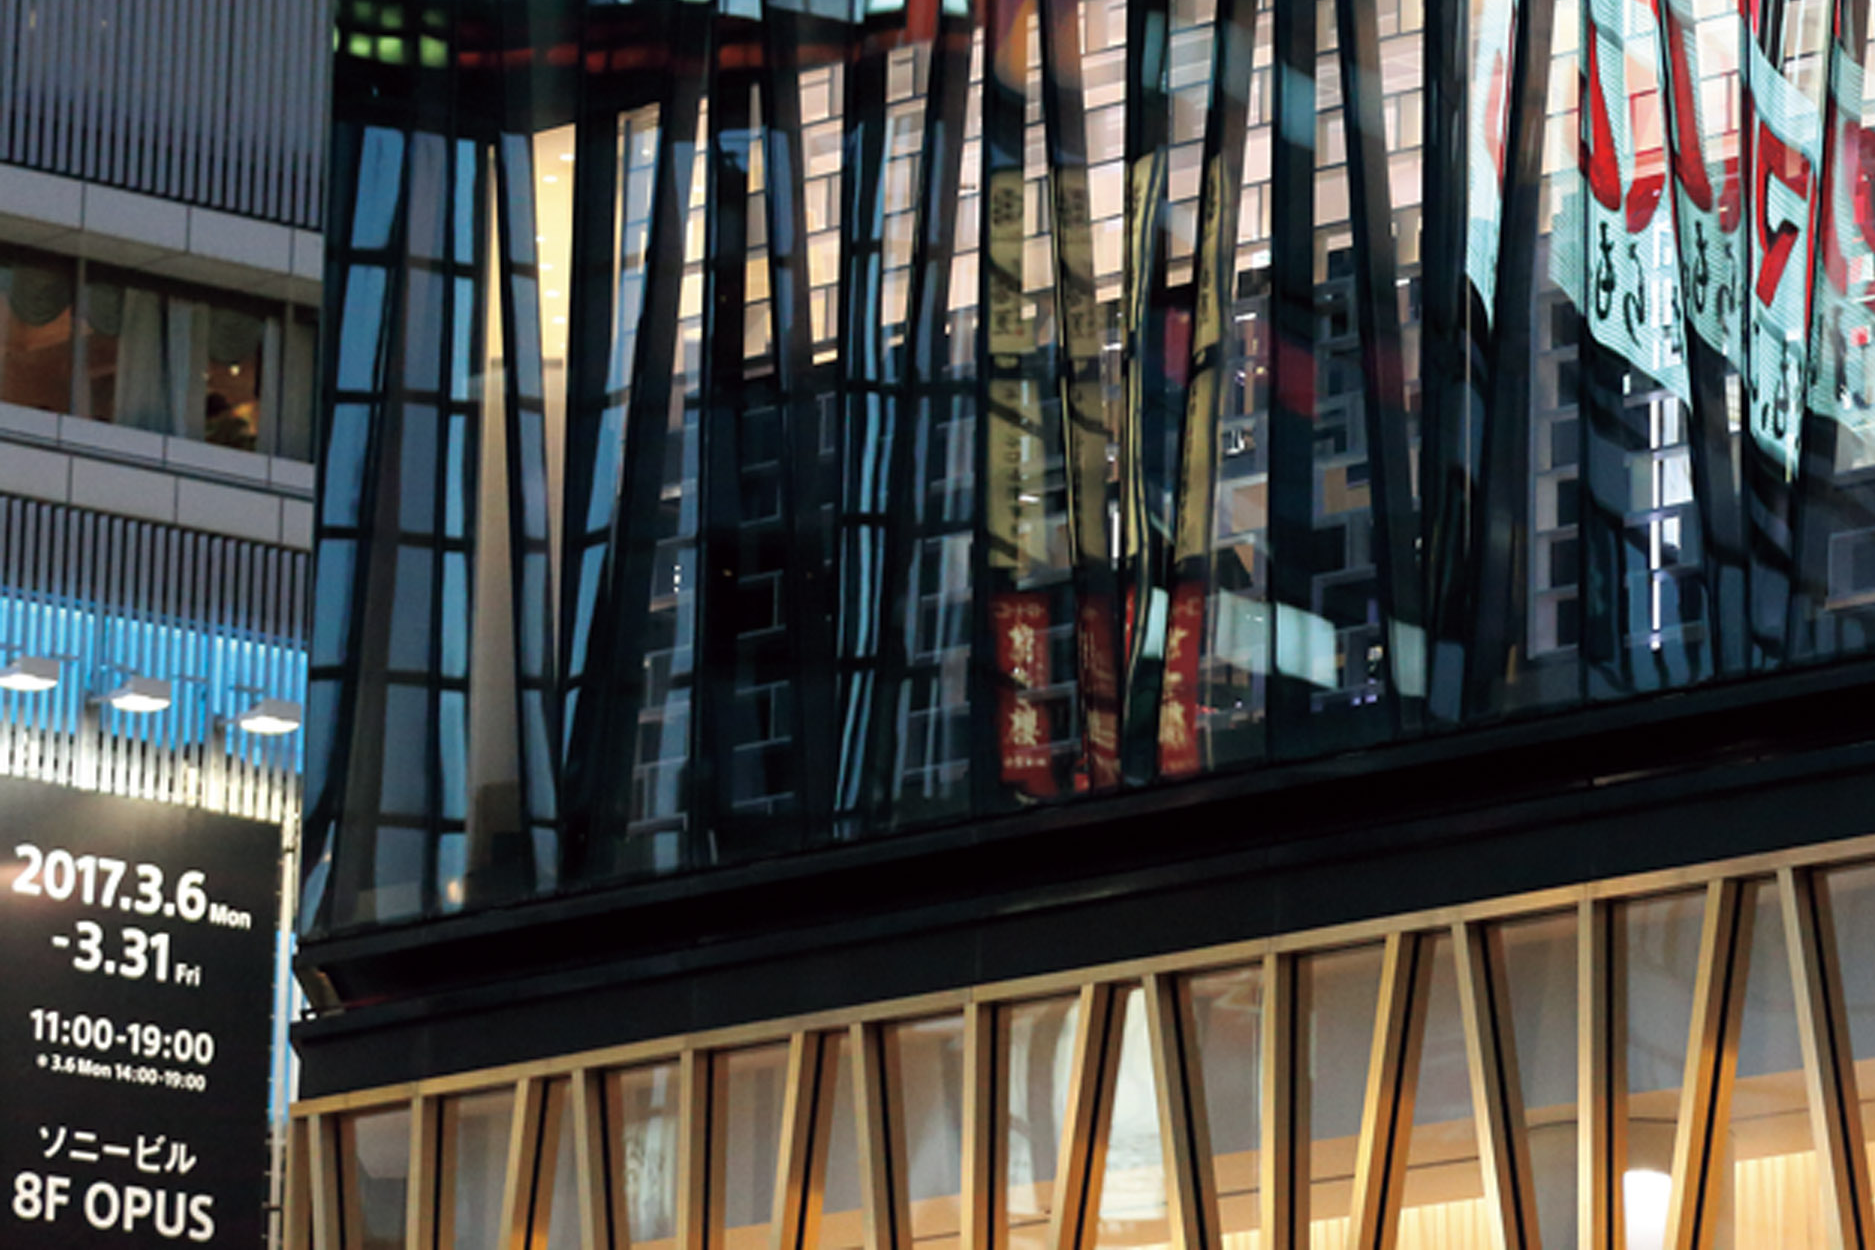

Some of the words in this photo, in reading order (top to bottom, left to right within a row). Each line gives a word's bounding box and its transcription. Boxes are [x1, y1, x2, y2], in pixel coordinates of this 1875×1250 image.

[12, 844, 207, 921] 2017.3.6
[209, 902, 251, 929] Mon
[52, 920, 170, 982] -3.31
[174, 963, 201, 986] Fri
[29, 1008, 214, 1065] 11:00-19:00
[39, 1126, 197, 1174] ソニービル
[12, 1172, 71, 1222] 8F
[84, 1182, 215, 1241] OPUS
